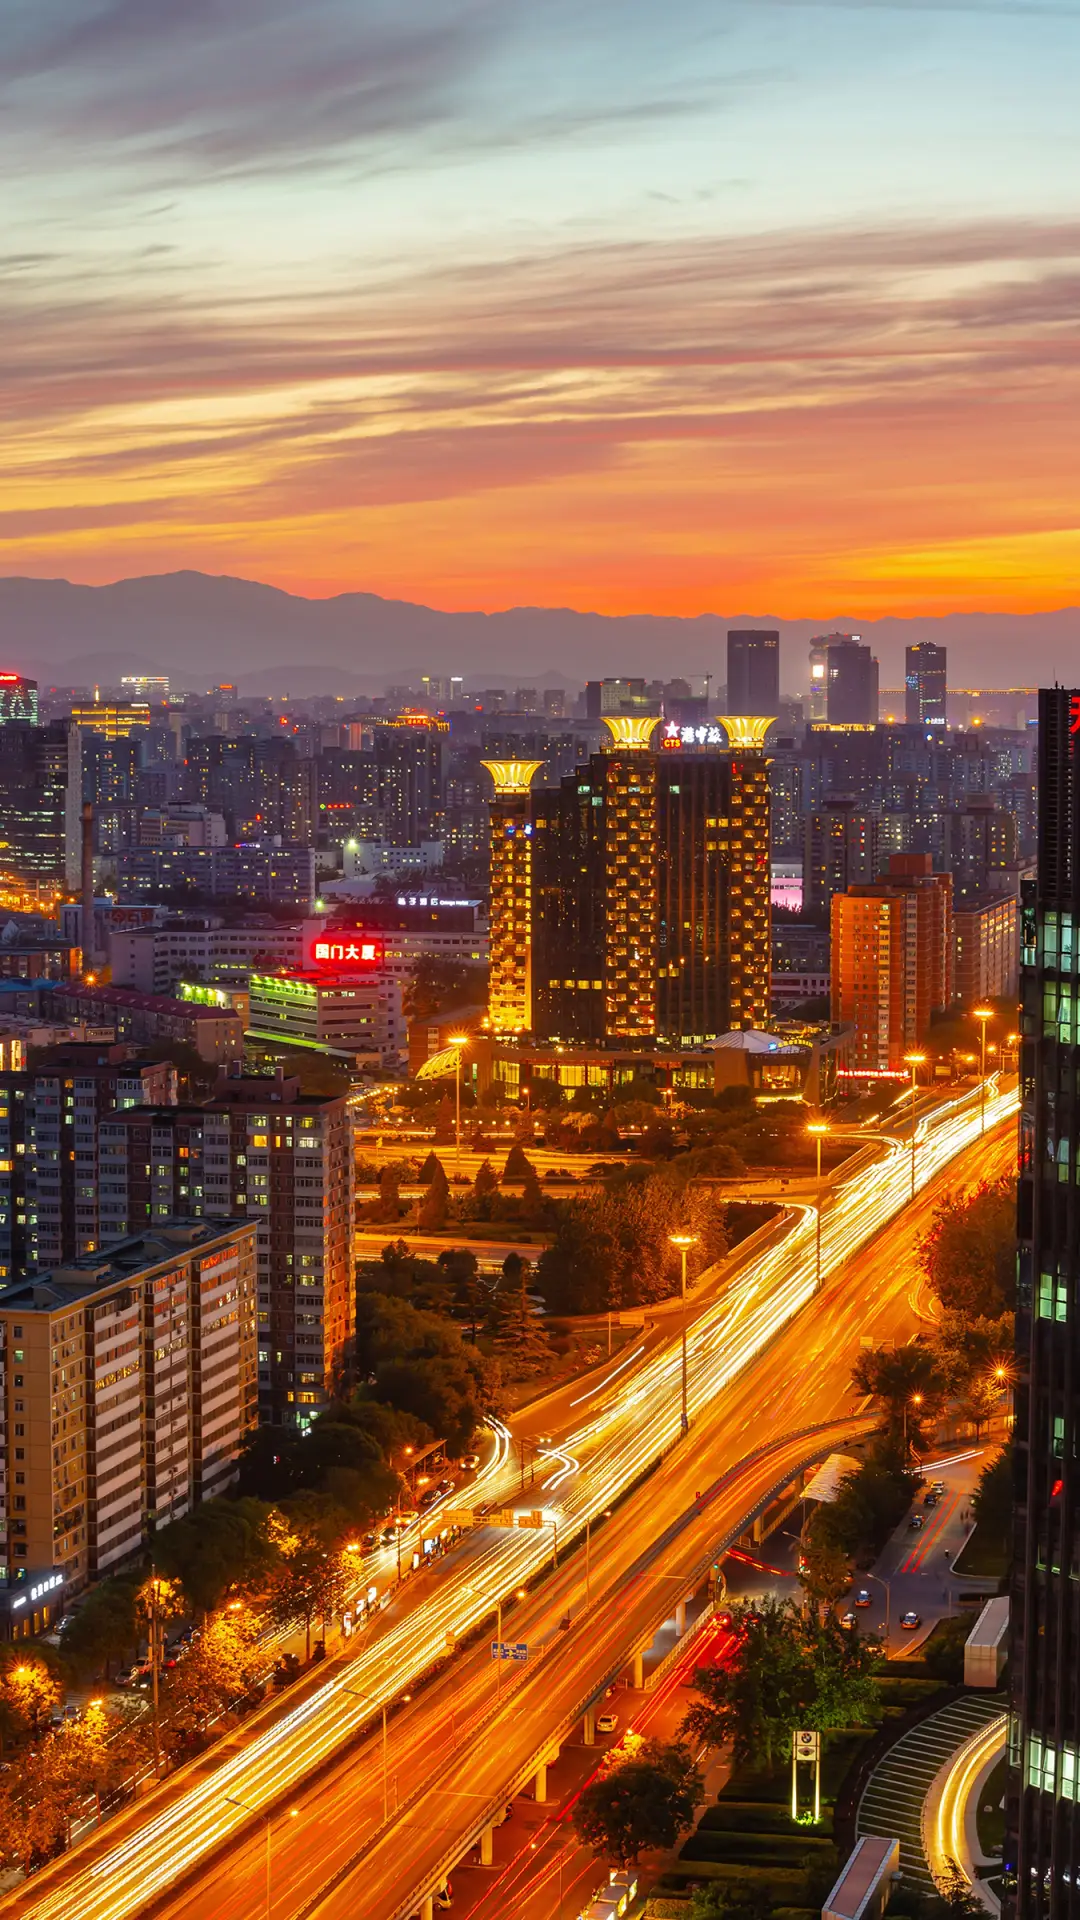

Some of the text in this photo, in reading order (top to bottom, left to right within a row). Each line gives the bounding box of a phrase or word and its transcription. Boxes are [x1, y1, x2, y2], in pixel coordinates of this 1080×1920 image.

[664, 739, 681, 748] CTS
[680, 726, 722, 744] 港中旅
[315, 943, 375, 960] 国门大厦
